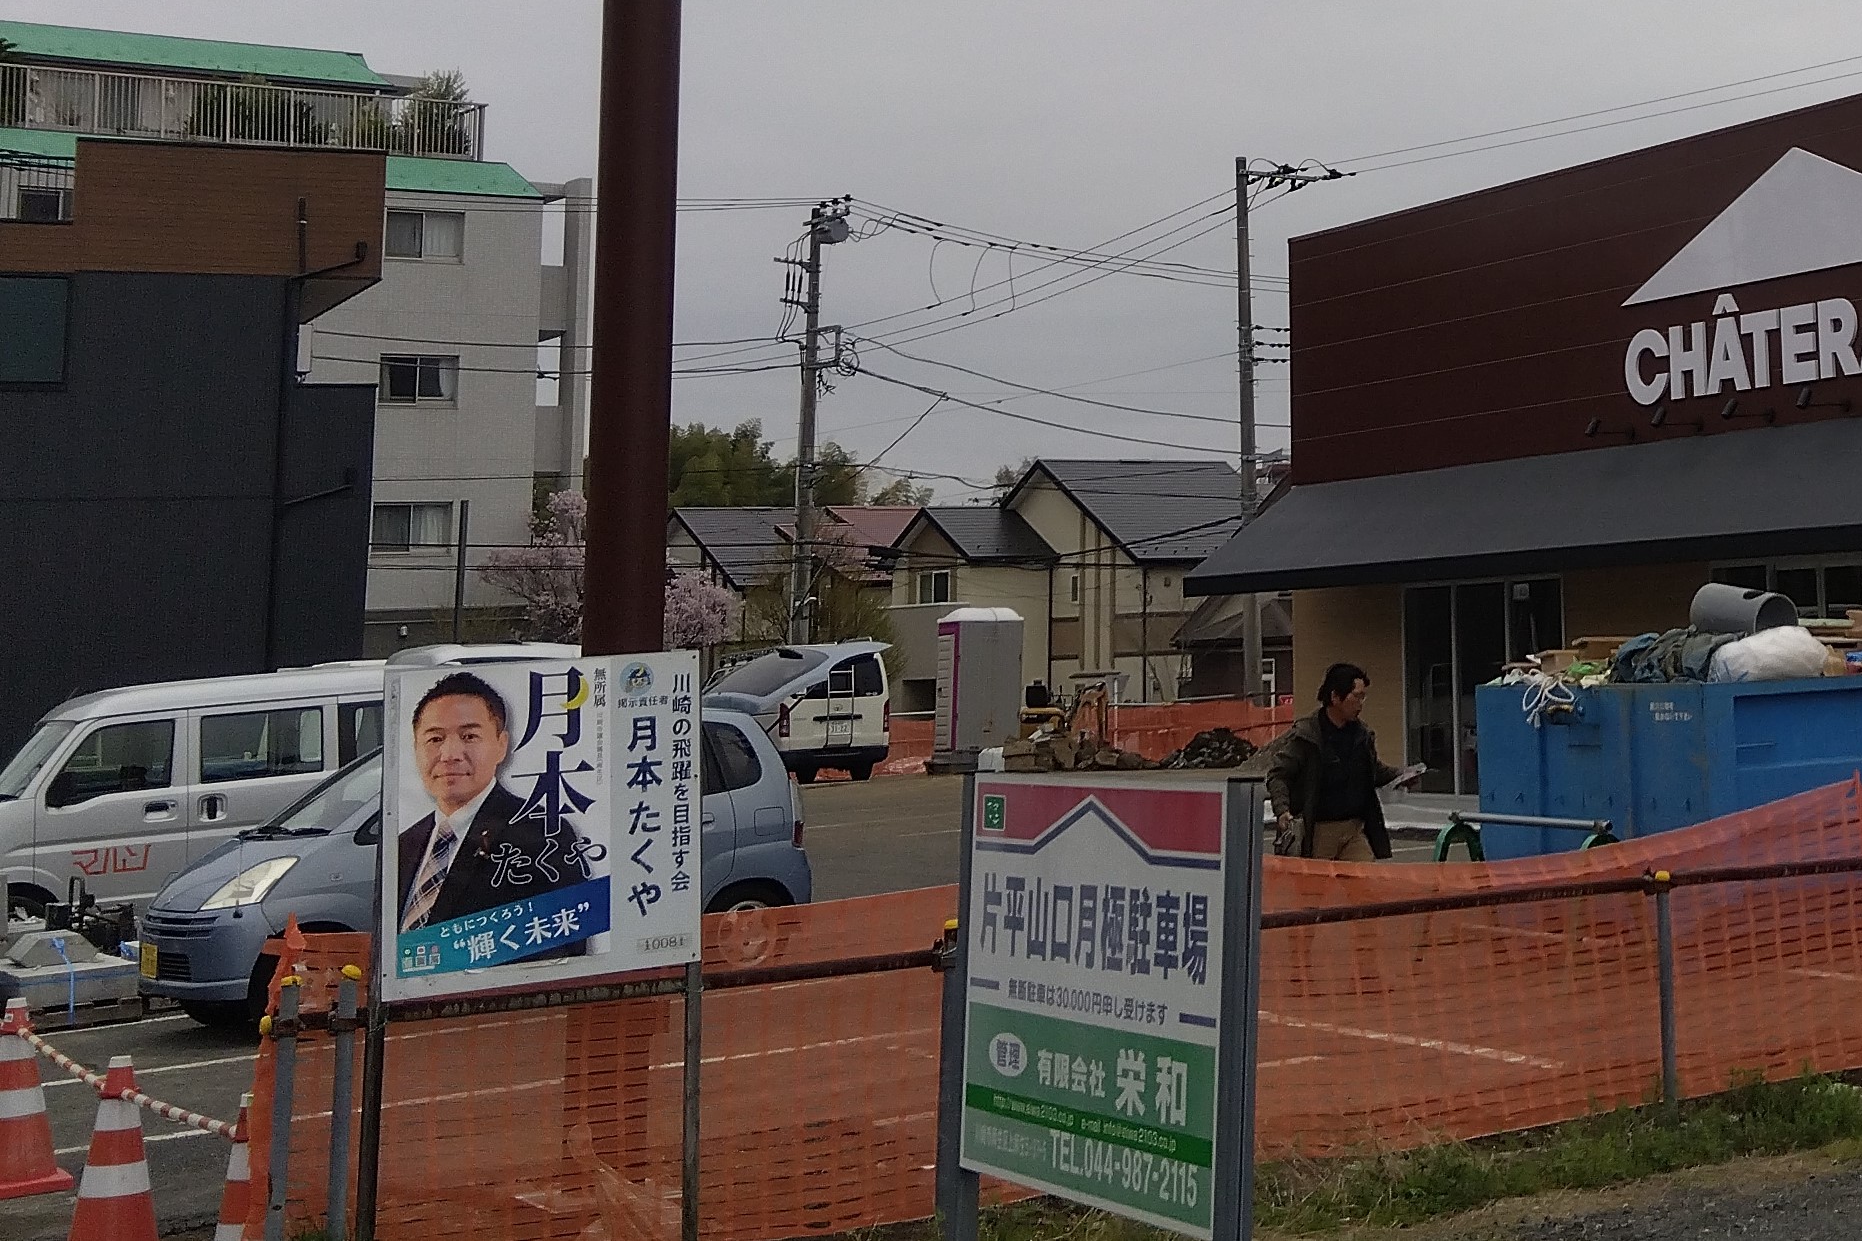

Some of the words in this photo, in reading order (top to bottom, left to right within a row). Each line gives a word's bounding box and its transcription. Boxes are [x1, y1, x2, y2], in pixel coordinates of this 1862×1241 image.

[593, 667, 607, 708] 無所属
[509, 666, 596, 837] 月本
[671, 672, 692, 893] 川崎の飛躍を目指す会
[490, 836, 608, 888] たくや
[980, 872, 1209, 986] 片平山口月極駐車場
[1037, 1048, 1106, 1098] 有限会社
[1115, 1048, 1188, 1127] 栄和
